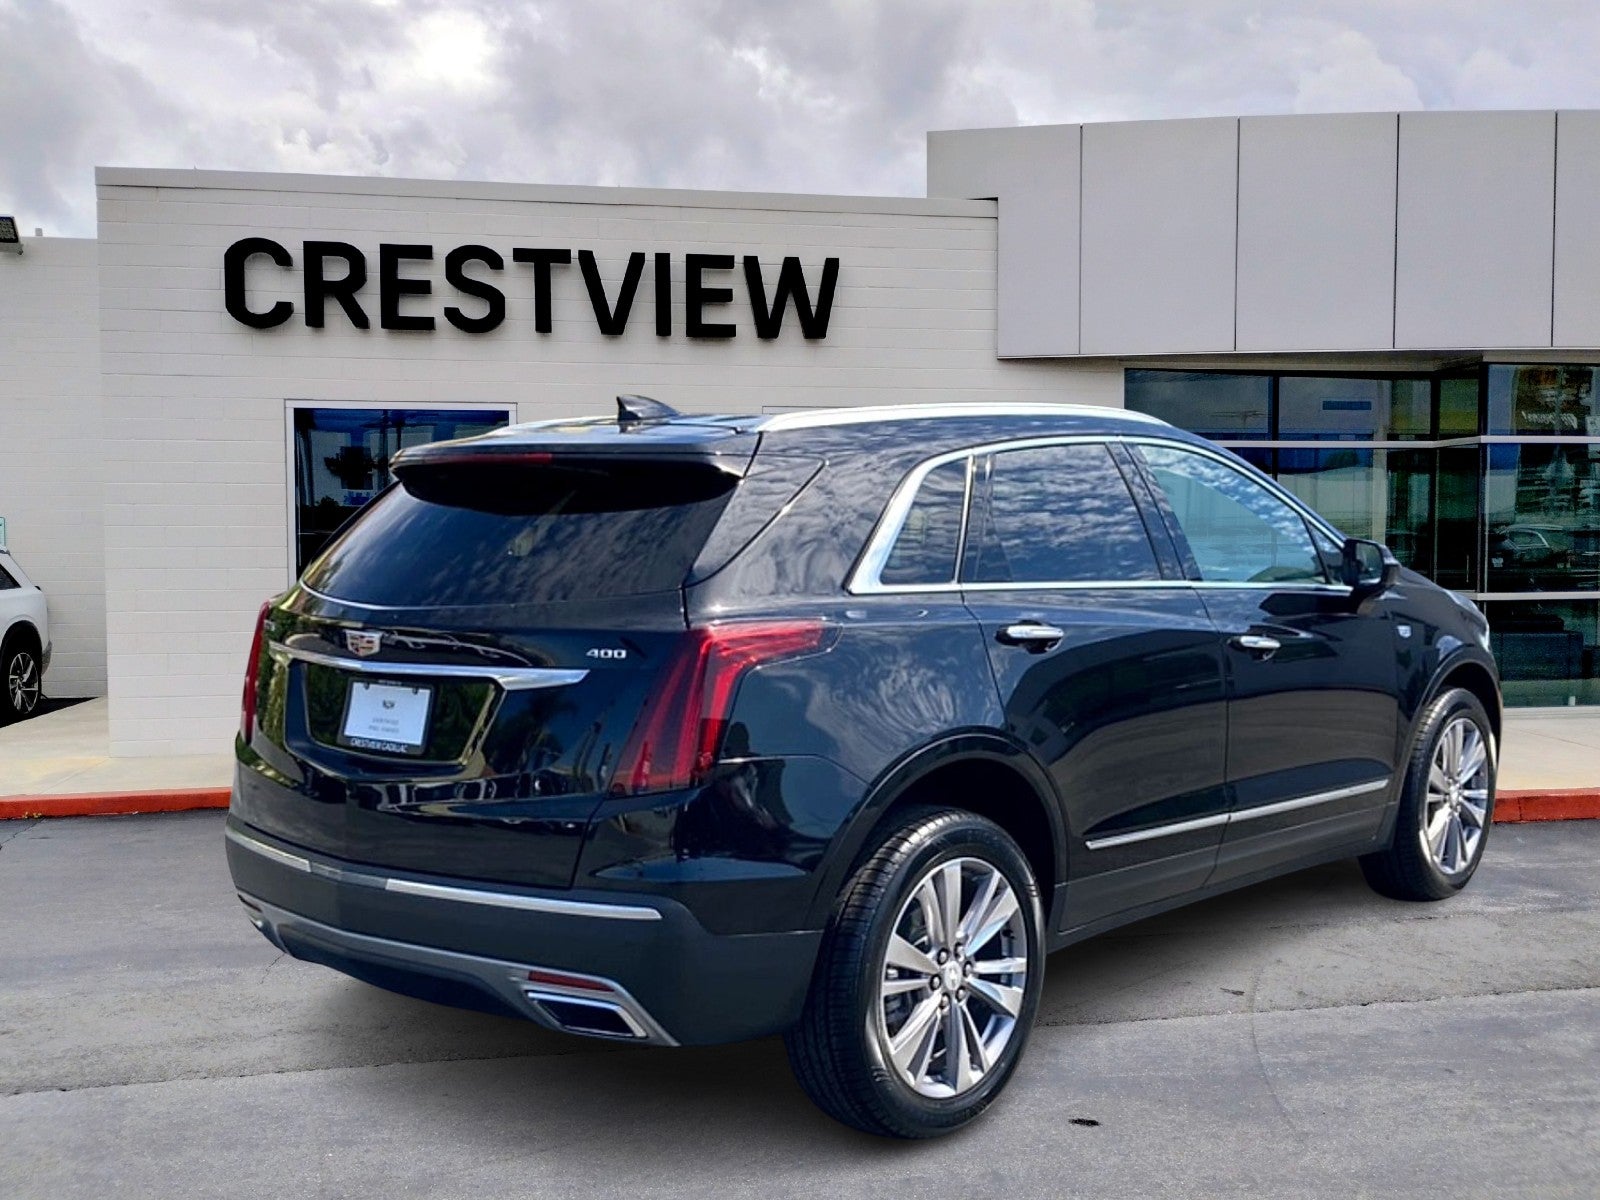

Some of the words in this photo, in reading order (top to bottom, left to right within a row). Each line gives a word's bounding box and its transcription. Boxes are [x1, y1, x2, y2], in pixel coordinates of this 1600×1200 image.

[224, 237, 840, 340] CRESTVIEW
[586, 648, 627, 659] 400
[381, 742, 408, 753] CADILLAC
